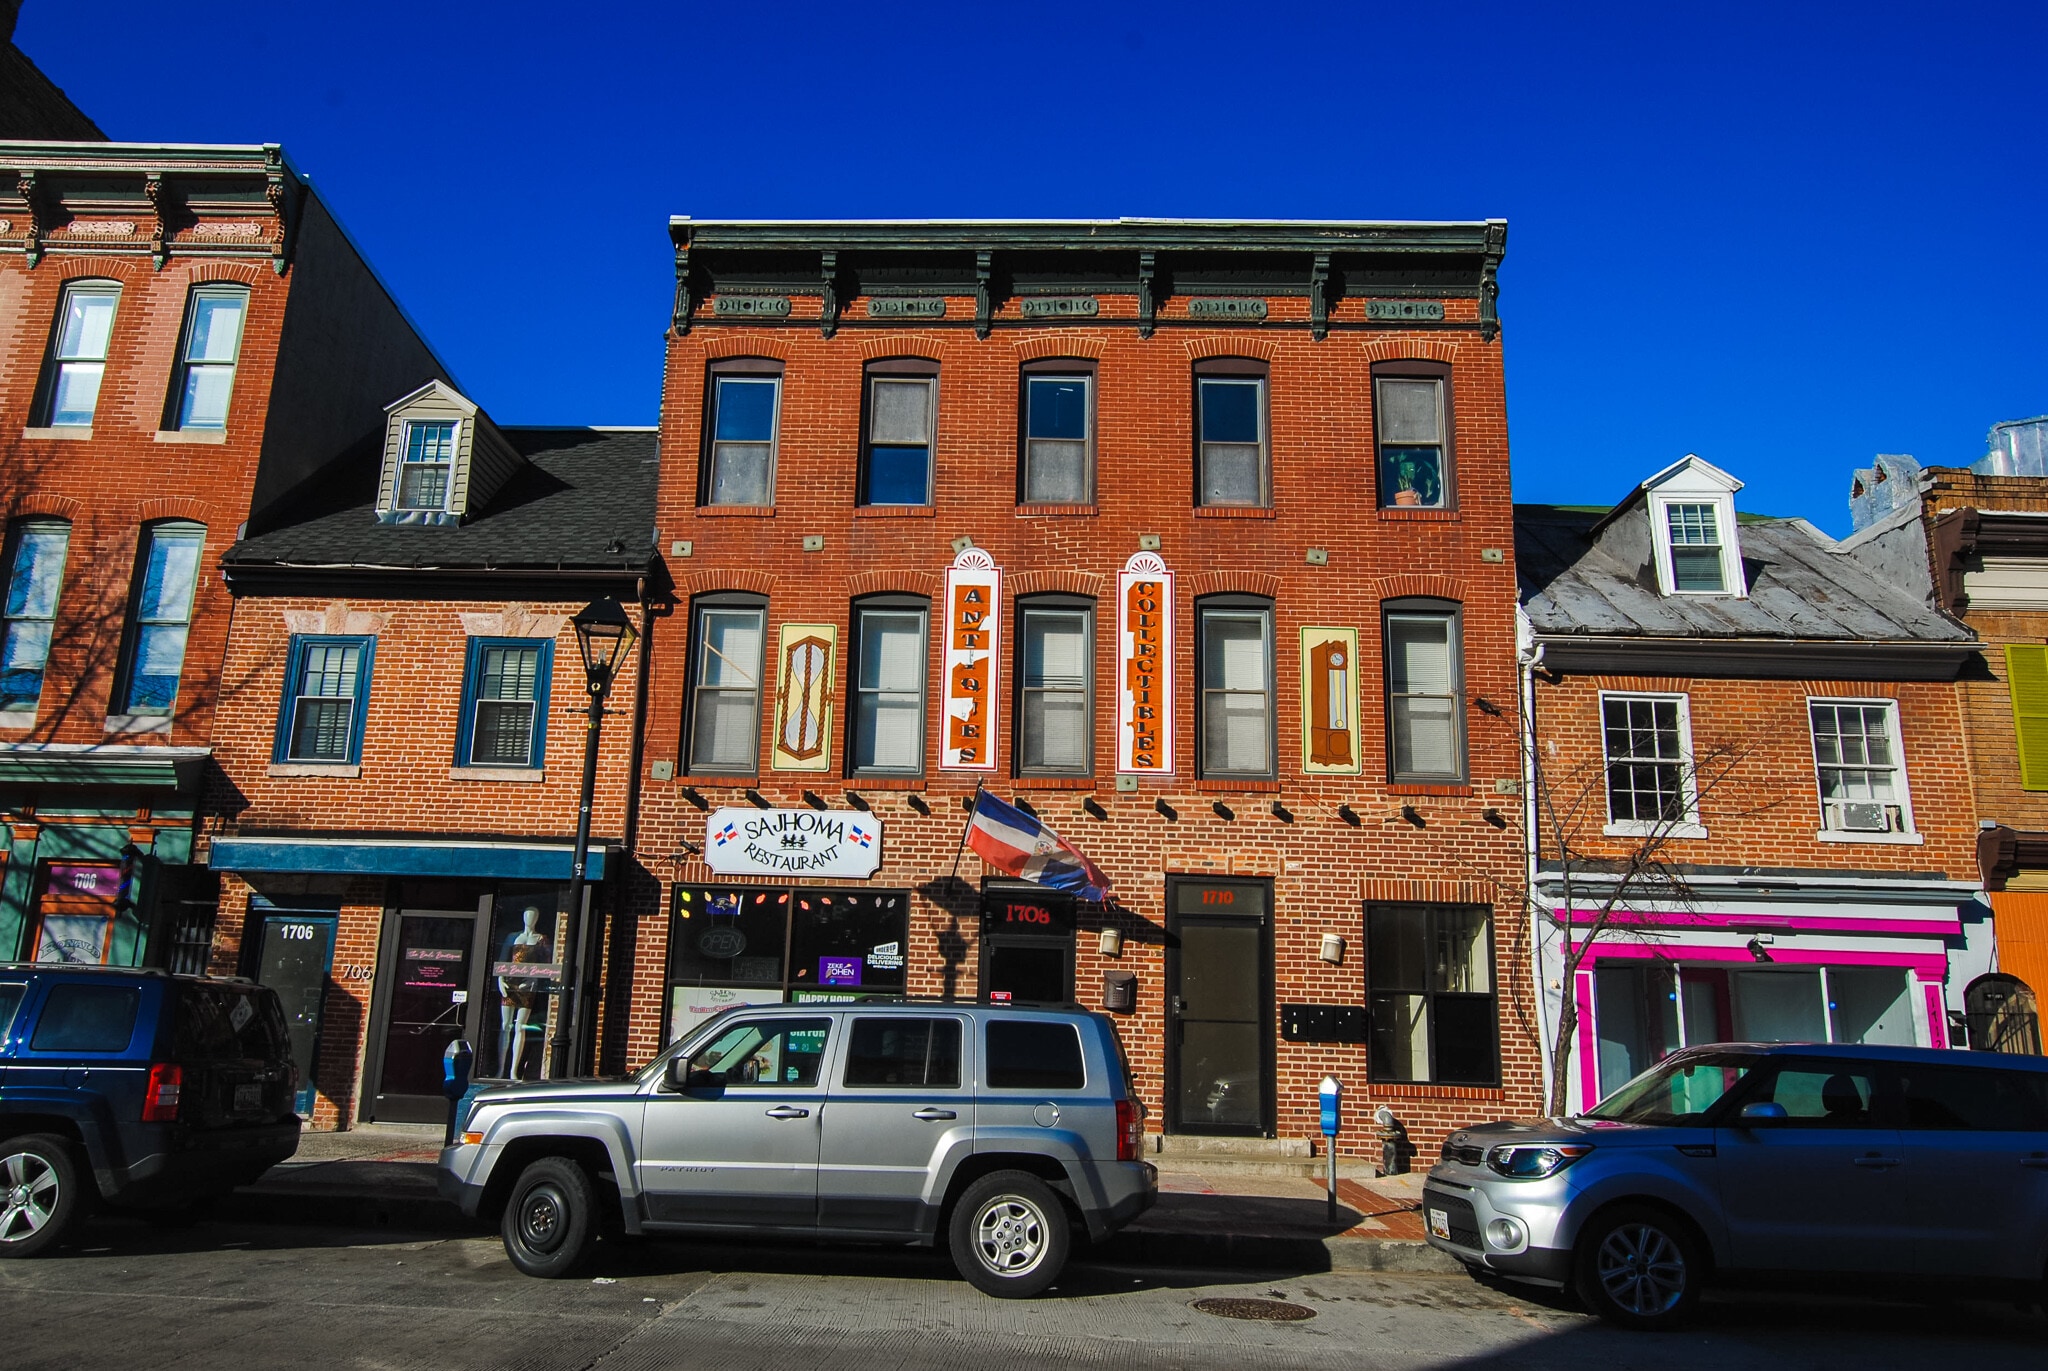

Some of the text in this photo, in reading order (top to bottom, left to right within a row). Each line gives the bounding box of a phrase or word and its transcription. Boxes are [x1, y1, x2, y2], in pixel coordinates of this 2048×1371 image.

[1136, 581, 1156, 768] COLLECTIBLES
[744, 812, 844, 845] SAJHOMA
[743, 842, 839, 872] RESTAURANT
[74, 873, 97, 889] 1706
[1202, 890, 1235, 905] 1710
[1006, 904, 1051, 924] 1708
[281, 924, 314, 940] 1706
[701, 934, 741, 950] OPEN
[829, 968, 855, 976] OHEN
[799, 994, 828, 1003] HAPPY
